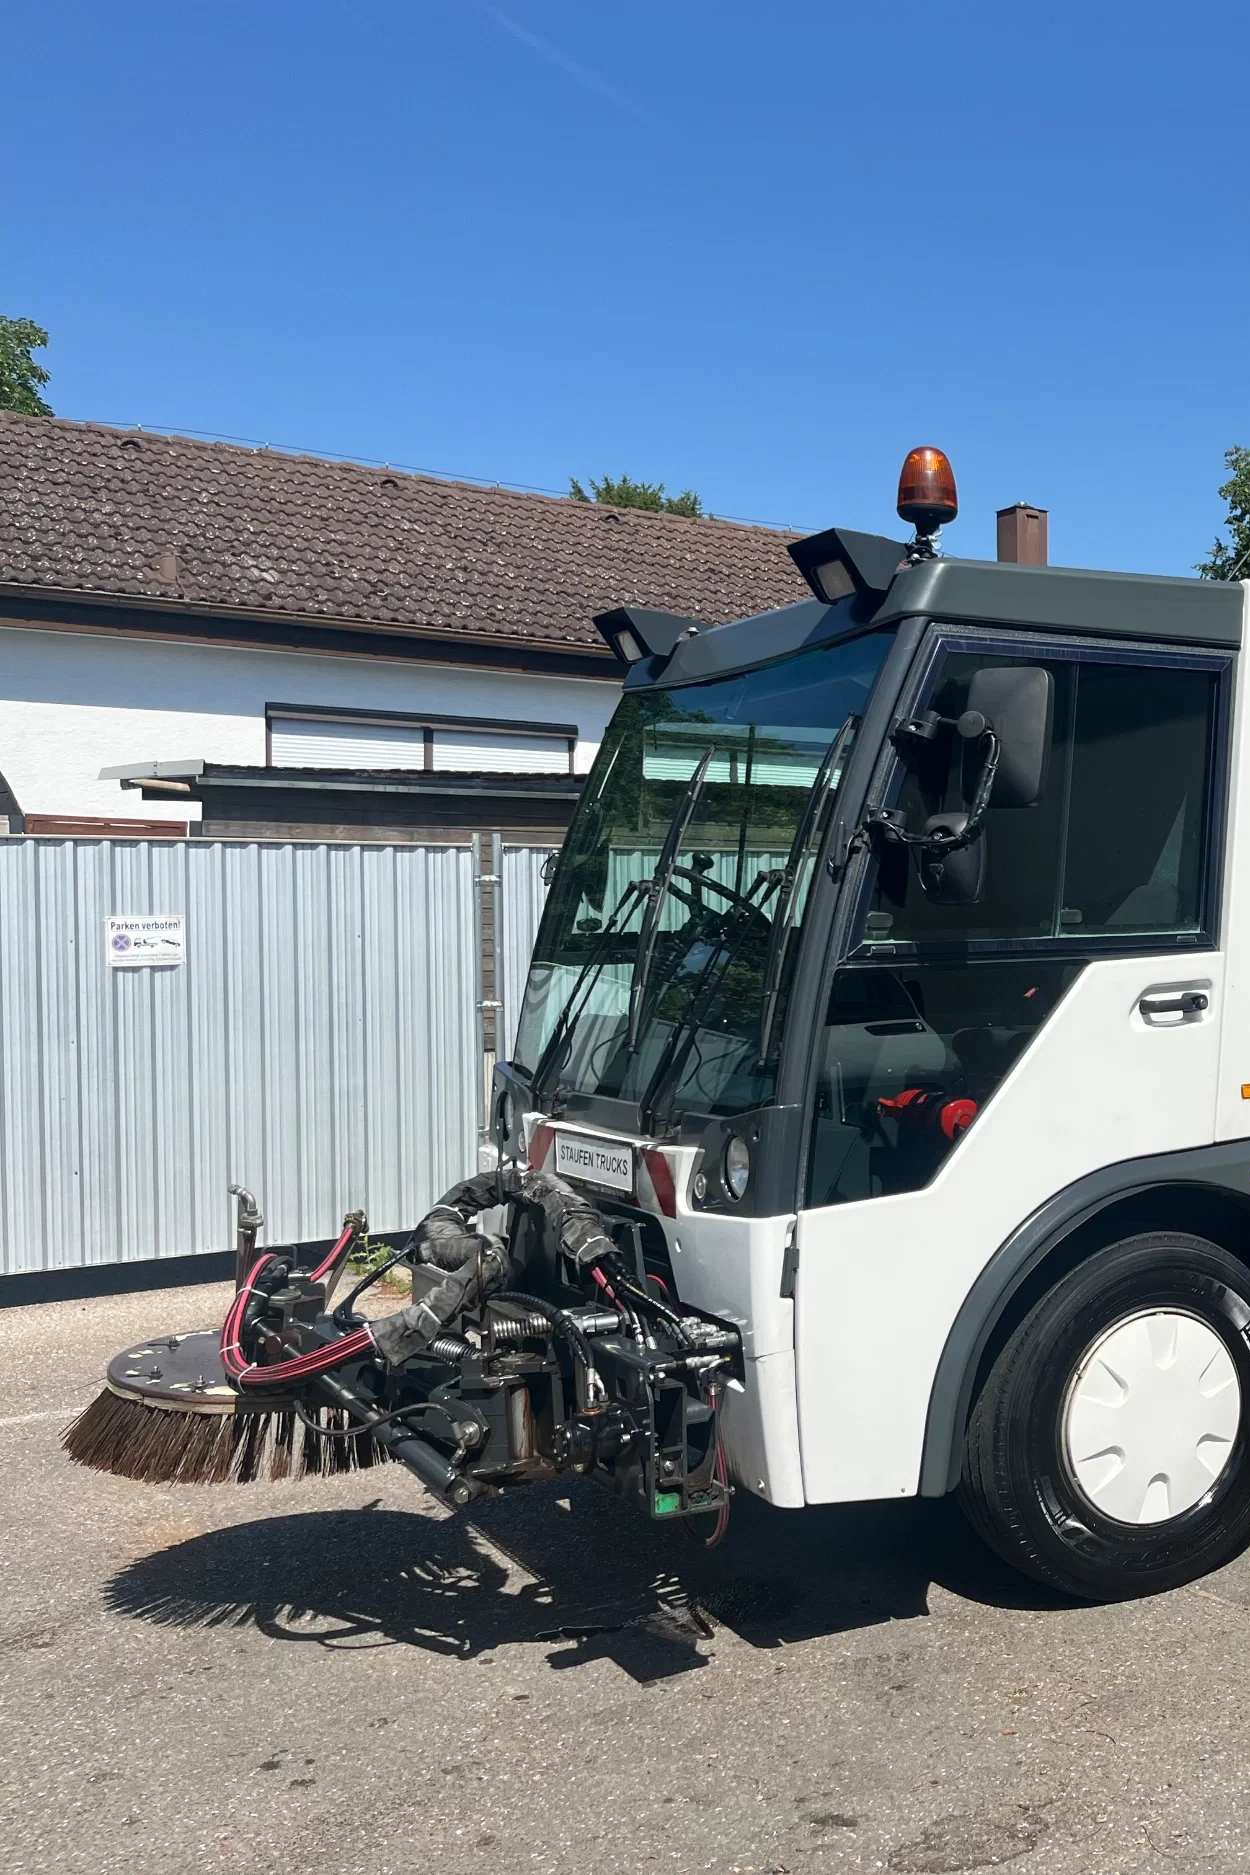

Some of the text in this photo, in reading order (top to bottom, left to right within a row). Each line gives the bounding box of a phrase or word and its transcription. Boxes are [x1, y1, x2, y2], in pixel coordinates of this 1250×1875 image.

[110, 920, 181, 931] Parken verboten!
[560, 1144, 628, 1177] STAUFEN TRUCKS
